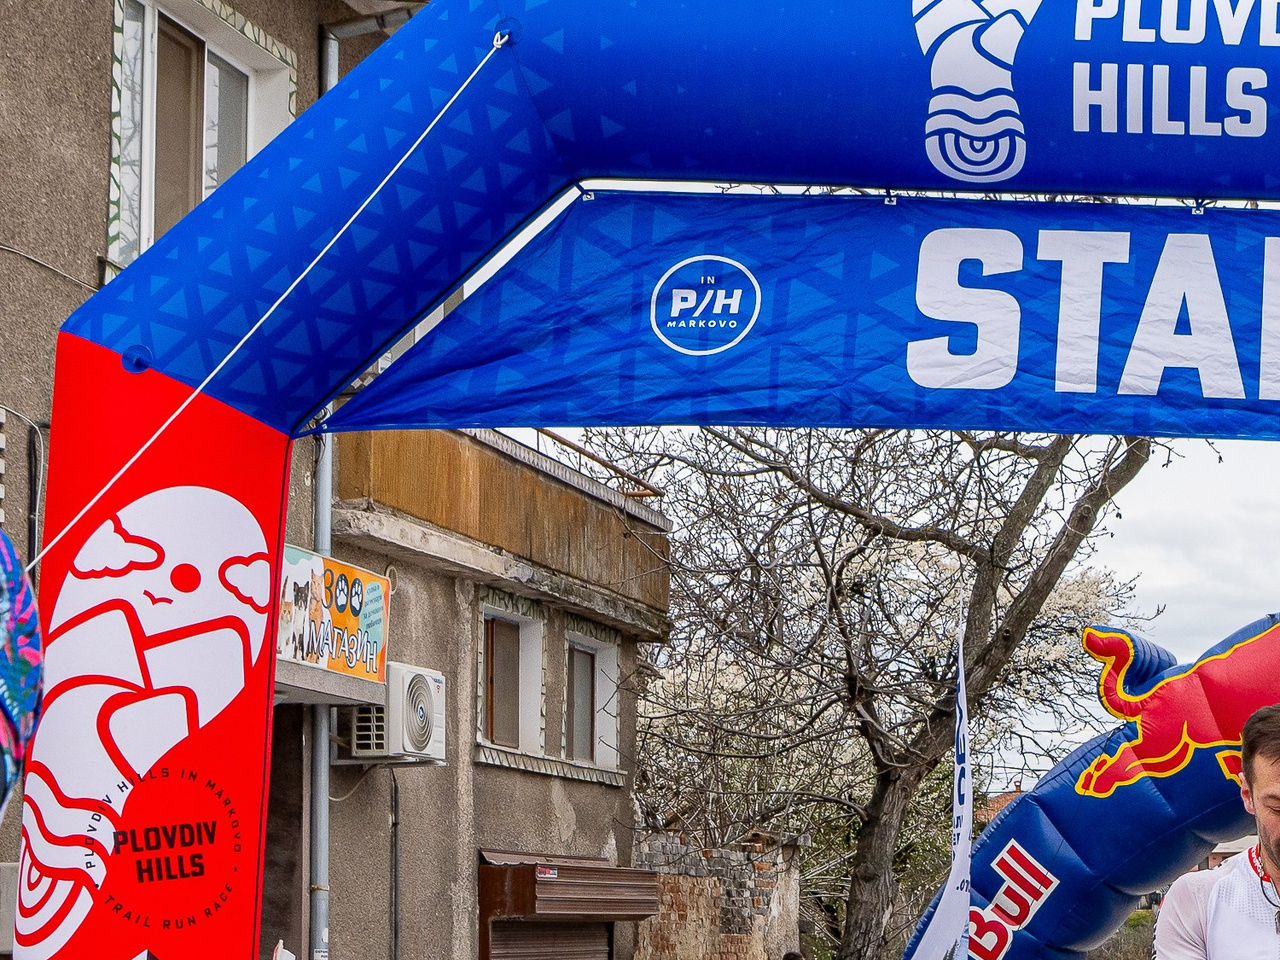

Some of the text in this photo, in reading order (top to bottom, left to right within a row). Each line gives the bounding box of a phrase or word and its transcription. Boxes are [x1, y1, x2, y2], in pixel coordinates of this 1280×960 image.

[1073, 62, 1267, 137] HILLS
[701, 276, 715, 284] IN
[670, 289, 743, 317] P/H
[667, 320, 737, 328] MARKOVO
[308, 619, 378, 673] МАГАЗИН
[85, 768, 241, 869] PLOVDIV HILLS IN MARKOVO
[113, 821, 217, 854] PLOVDIV
[136, 853, 205, 883] HILLS
[105, 883, 233, 929] TRAIL RUN RACE
